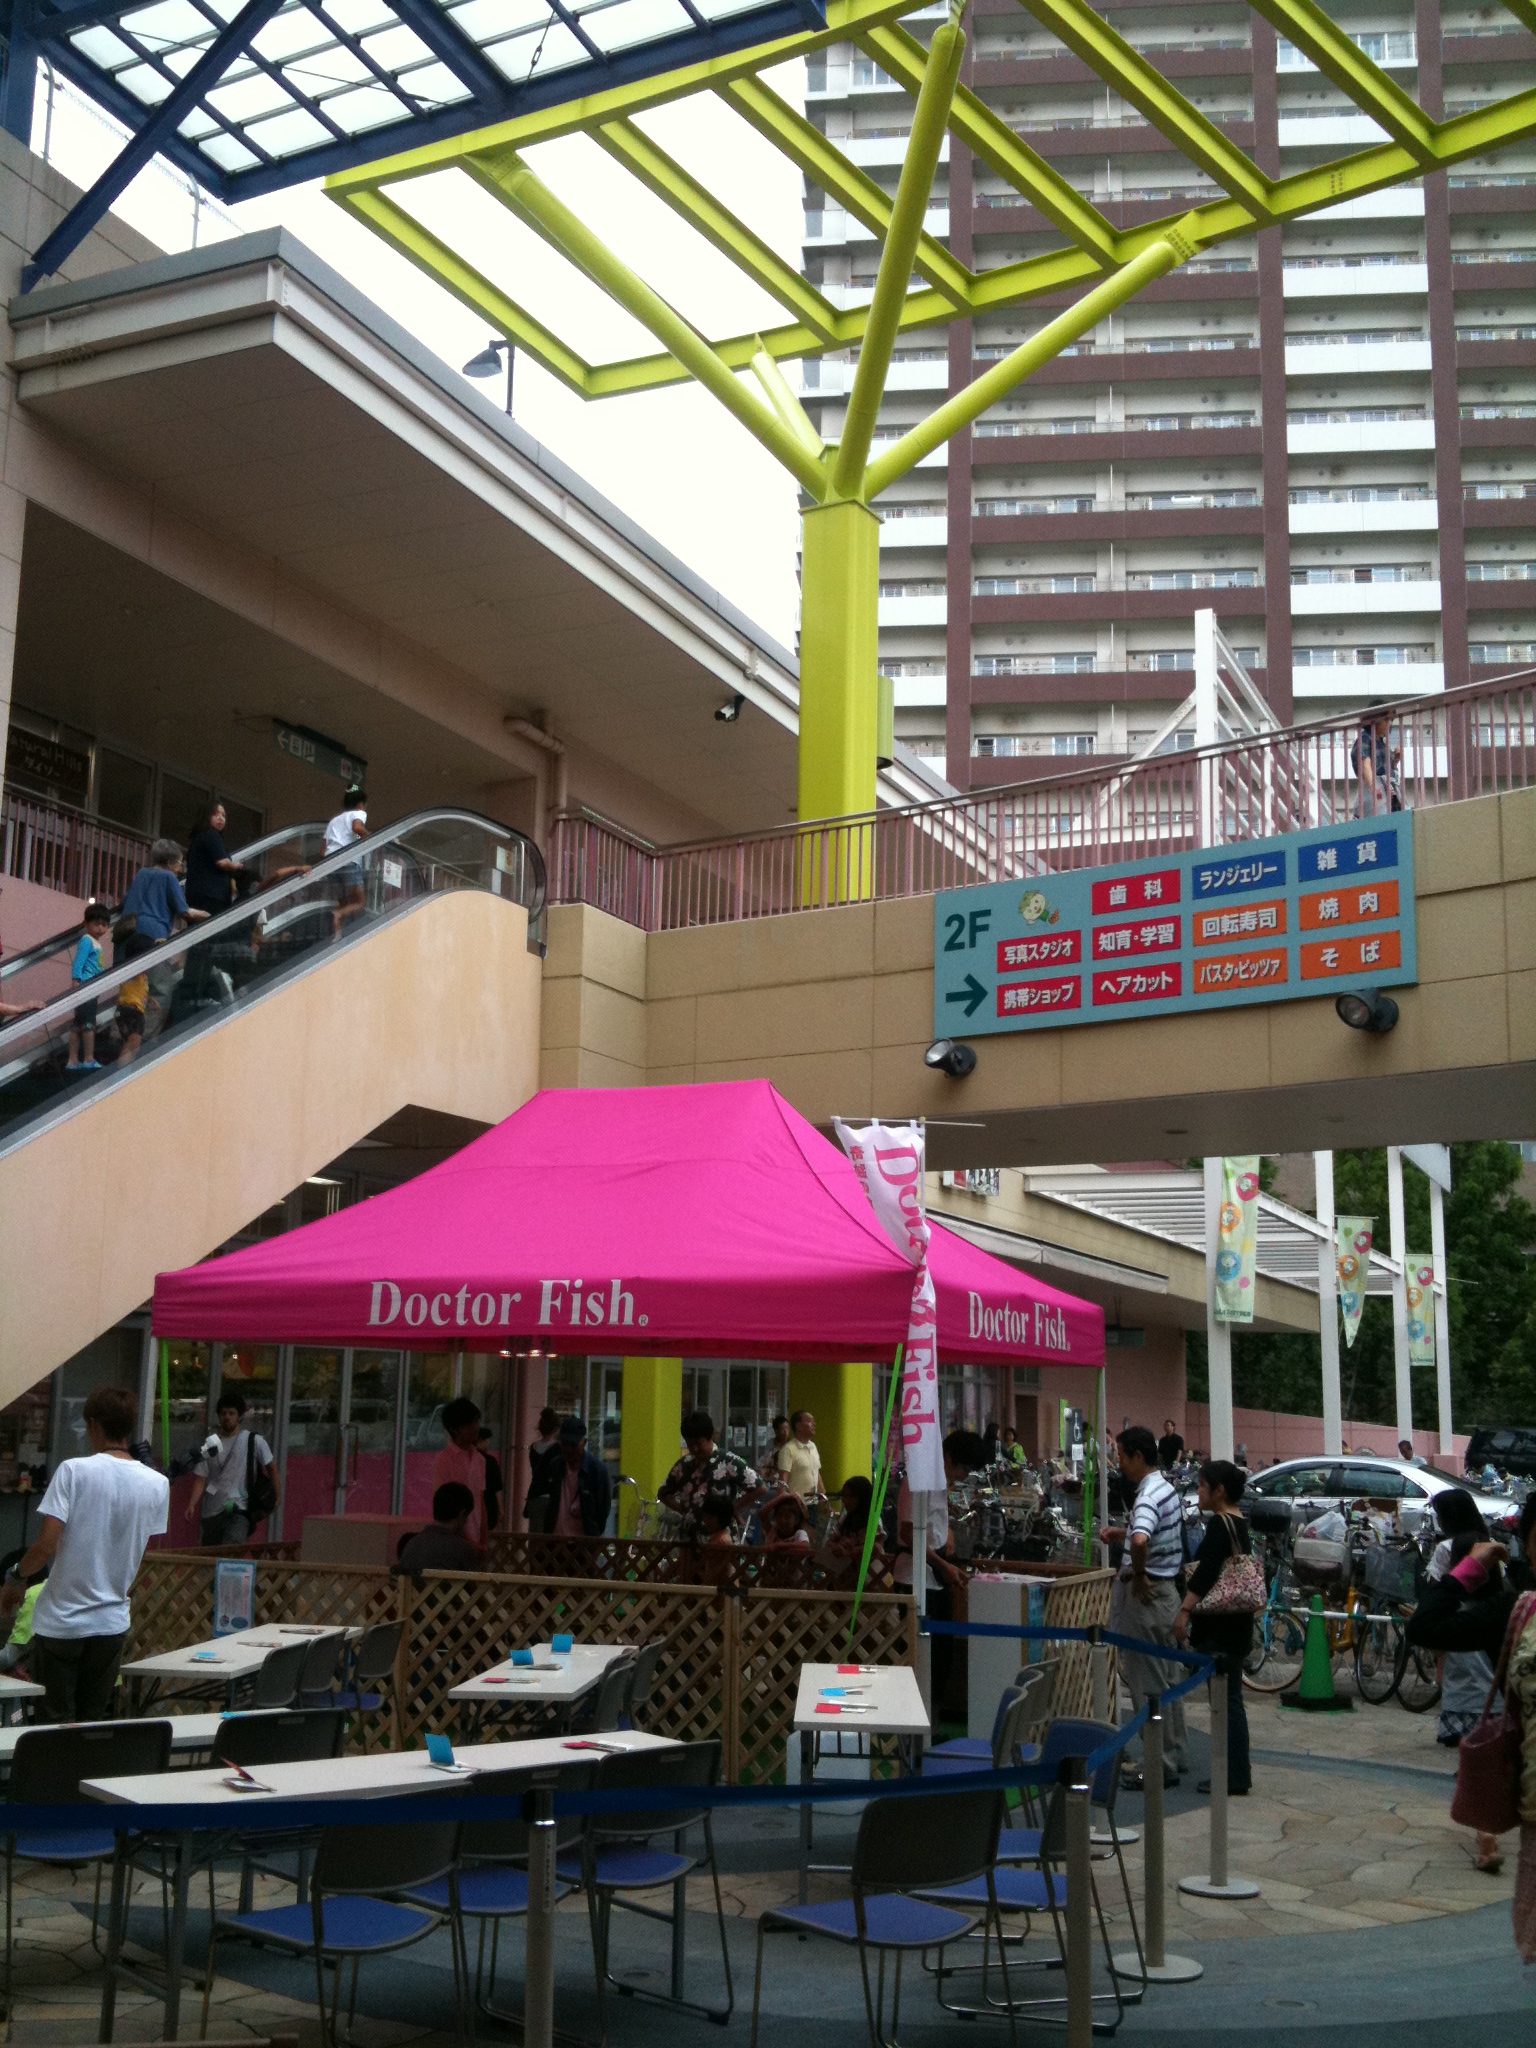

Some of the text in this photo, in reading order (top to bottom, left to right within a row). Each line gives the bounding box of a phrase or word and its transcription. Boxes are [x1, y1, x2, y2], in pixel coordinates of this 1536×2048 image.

[54, 747, 83, 773] Hills
[1199, 861, 1278, 890] ランジェリー
[944, 908, 992, 951] 2F
[1098, 922, 1175, 952] 知育・学習
[1202, 907, 1278, 938] 回転寿司
[1004, 938, 1074, 965] 写真スタジオ
[1004, 982, 1075, 1010] 携帯ショップ
[1100, 970, 1174, 996] ヘアカット
[366, 1280, 522, 1327] Doctor
[967, 1290, 1030, 1344] Doctor
